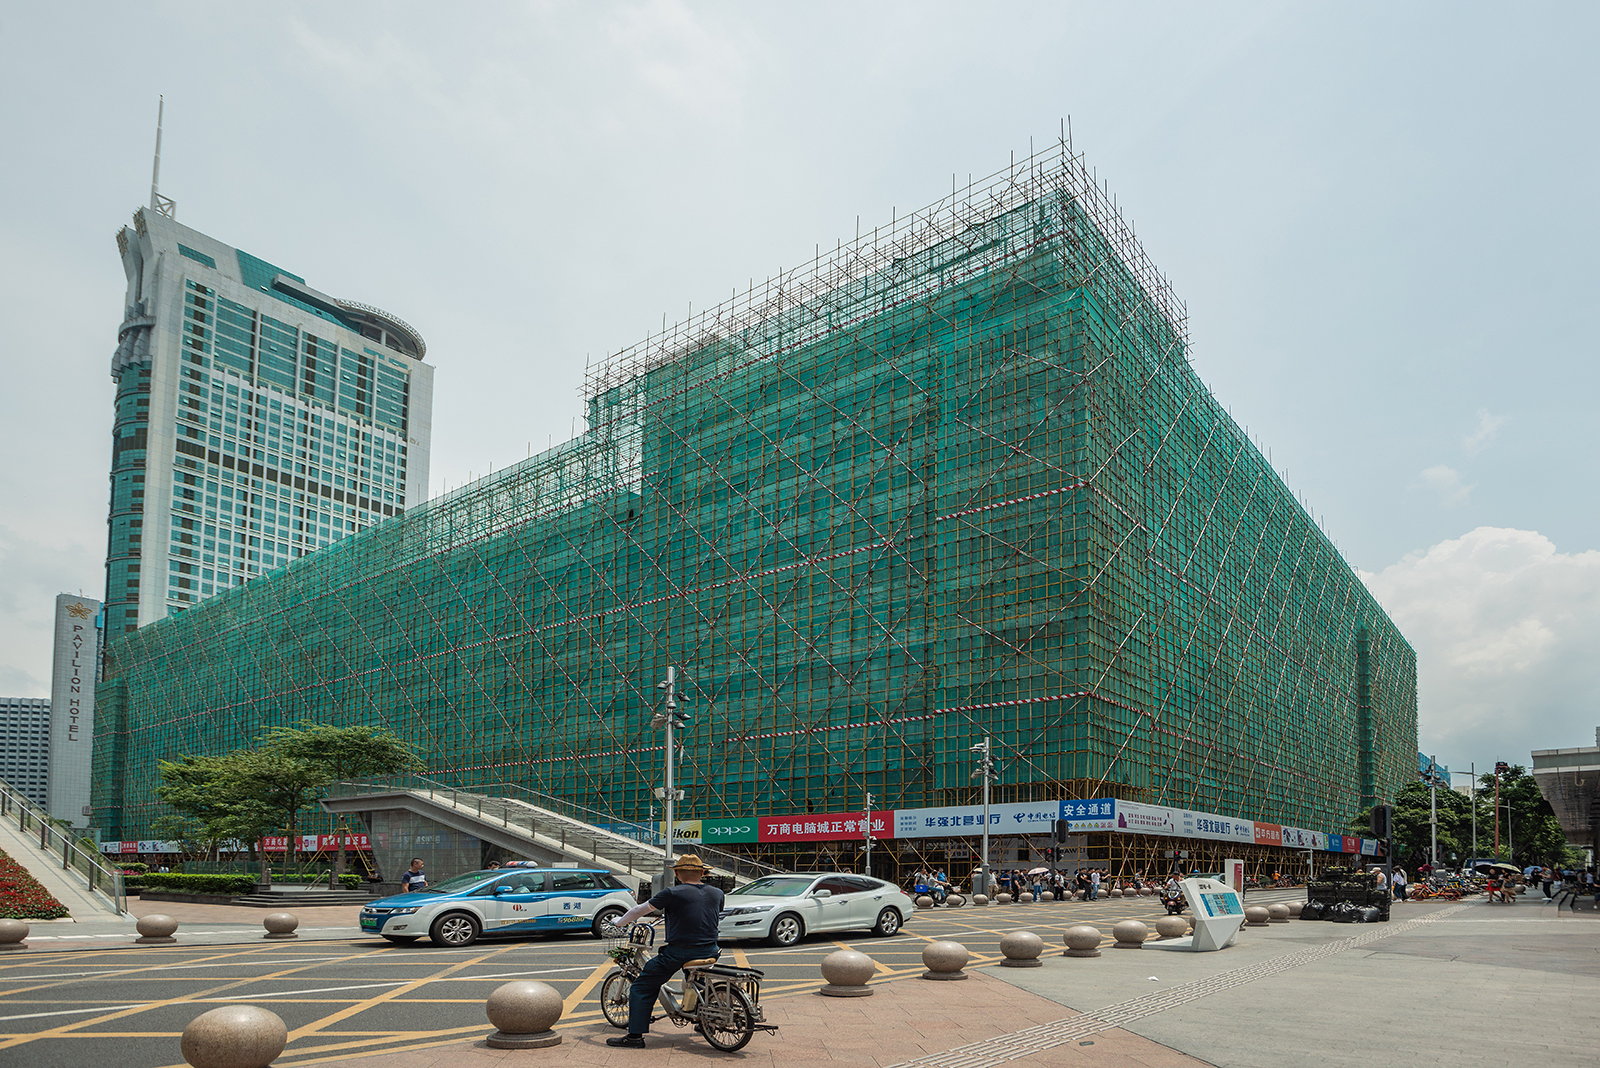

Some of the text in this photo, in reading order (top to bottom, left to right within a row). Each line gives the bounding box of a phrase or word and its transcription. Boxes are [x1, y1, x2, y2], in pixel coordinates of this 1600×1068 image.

[68, 625, 83, 741] PAVILION HOTEL
[1064, 802, 1111, 817] 安全通道
[663, 828, 699, 838] ikon
[767, 818, 886, 836] 万商电脑城正常营业
